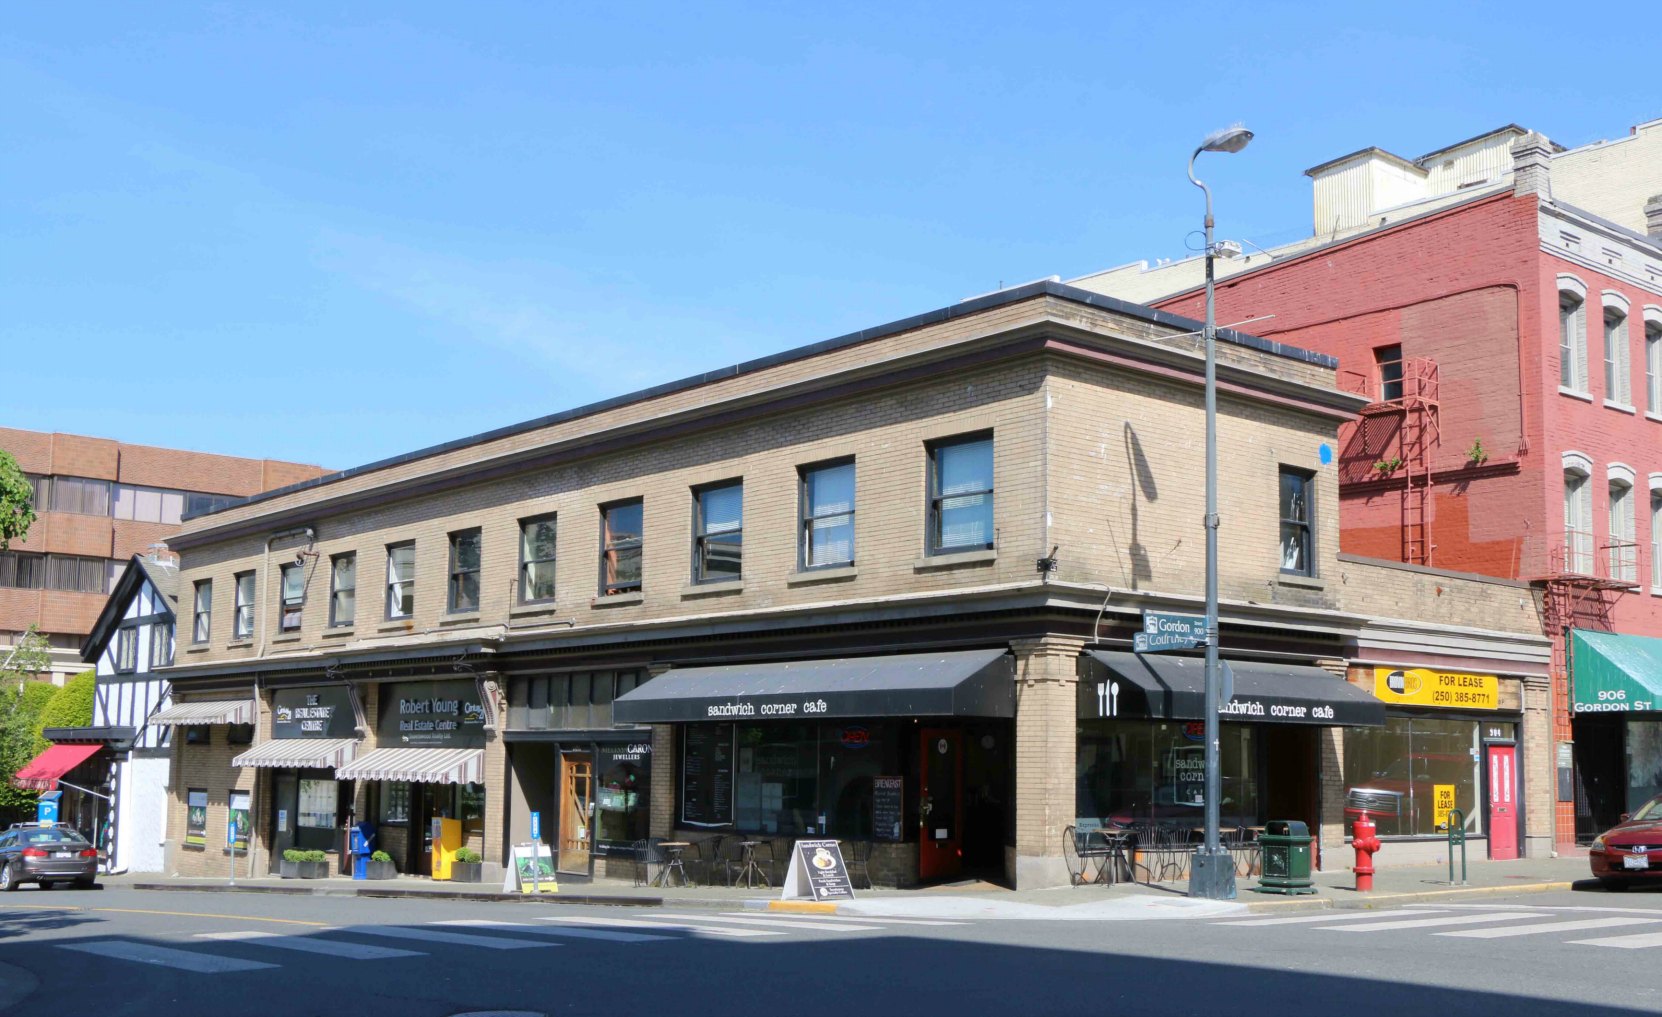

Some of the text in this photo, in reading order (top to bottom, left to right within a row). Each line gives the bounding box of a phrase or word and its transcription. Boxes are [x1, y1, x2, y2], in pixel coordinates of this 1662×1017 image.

[1159, 618, 1190, 633] Gordon
[1439, 675, 1484, 688] FOR LEASE
[1432, 691, 1490, 704] (250) 385-8771
[1598, 690, 1626, 700] 906
[400, 698, 458, 716] Robert Young
[707, 699, 827, 716] sandwich corner cafe
[1270, 704, 1307, 718] corner
[1312, 705, 1334, 719] cafe
[1574, 702, 1630, 712] GORDON
[400, 720, 458, 731] Real Estate Centre
[1186, 722, 1206, 736] OPE
[1489, 728, 1502, 737] 904
[627, 743, 655, 754] CARON
[612, 753, 640, 761] JEWELLERS
[1175, 757, 1205, 769] sandw
[1180, 771, 1205, 782] corn
[1440, 791, 1451, 799] FOR
[1438, 800, 1453, 809] LEASE
[44, 807, 51, 815] P
